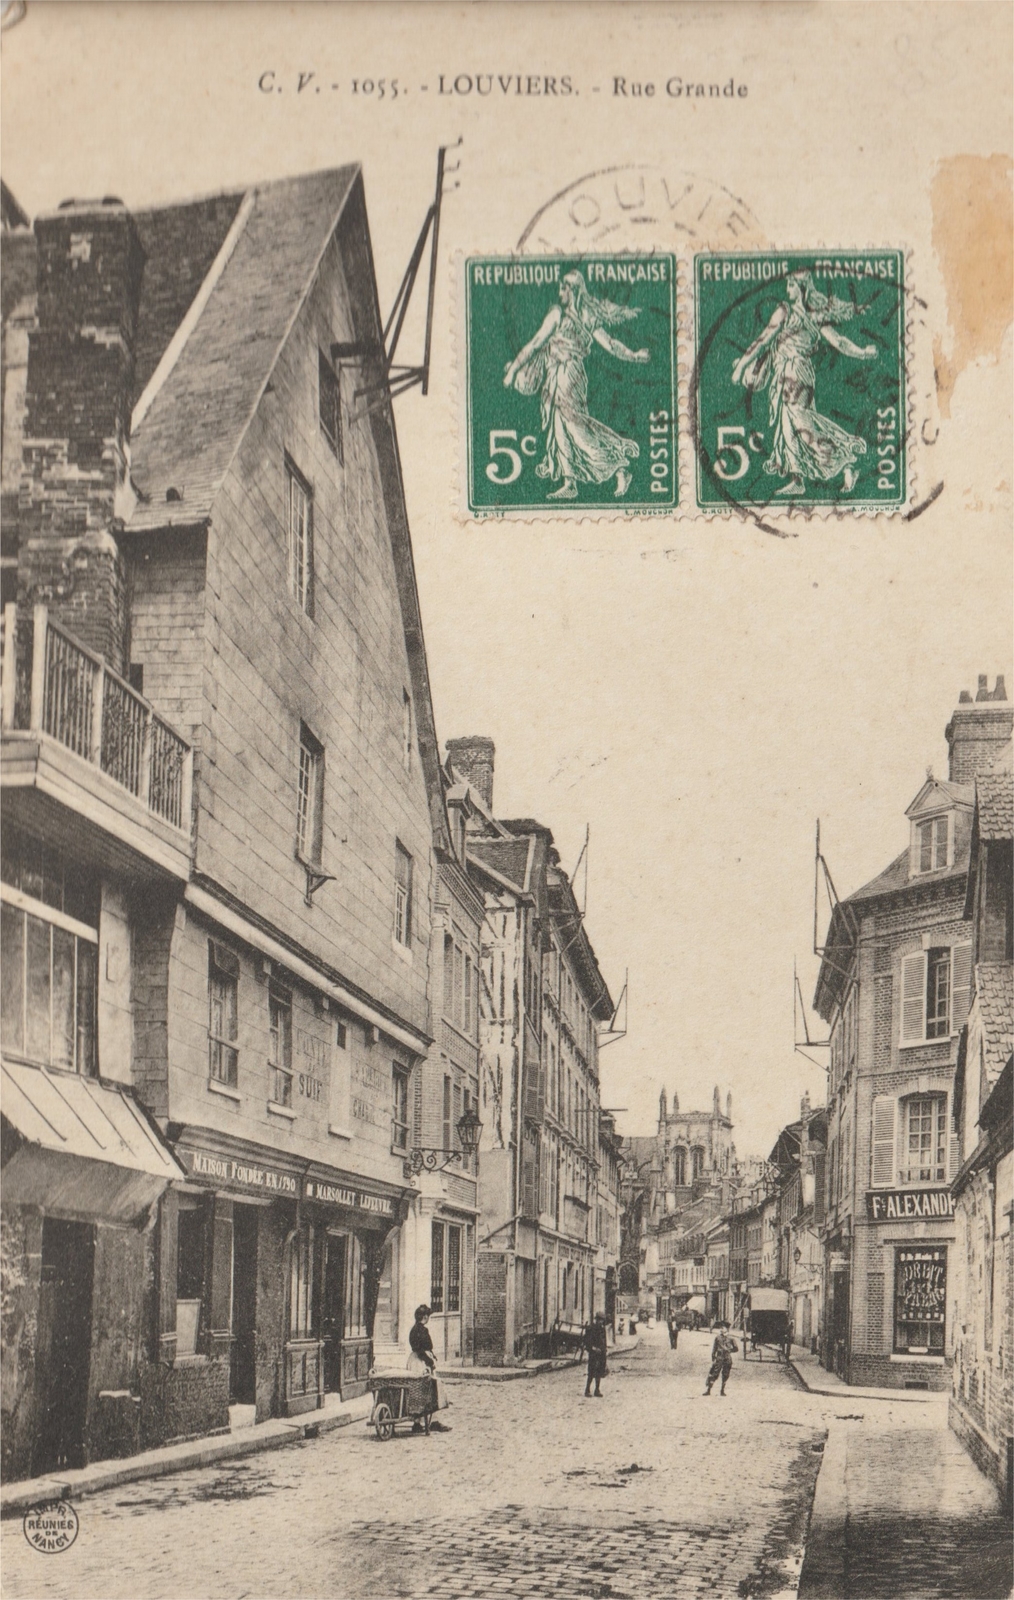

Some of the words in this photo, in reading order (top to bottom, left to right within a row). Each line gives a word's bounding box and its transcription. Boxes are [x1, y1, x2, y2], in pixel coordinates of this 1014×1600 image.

[587, 263, 667, 284] FRANÇAISE
[650, 409, 669, 493] POSTES
[877, 405, 896, 490] POSTES
[193, 1152, 228, 1179] MAISON
[266, 1172, 278, 1190] EN
[316, 1183, 356, 1206] MARSOLLET
